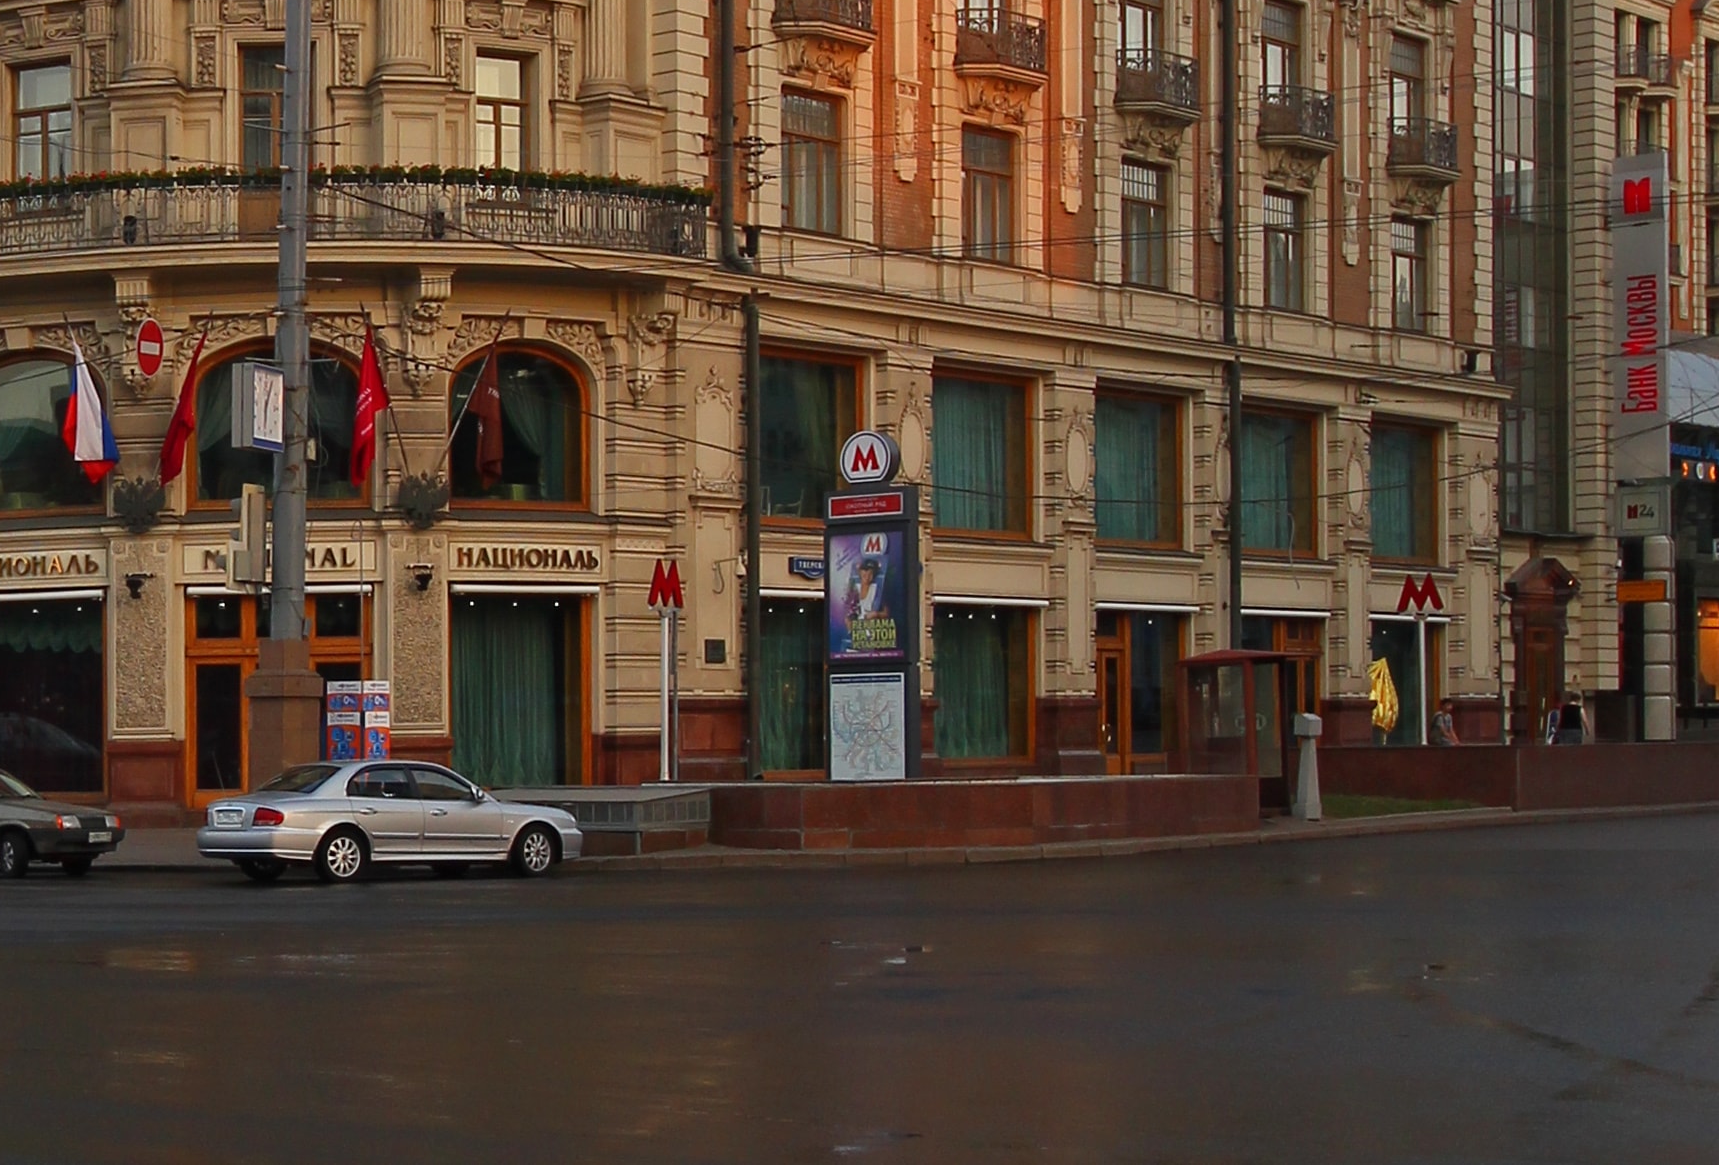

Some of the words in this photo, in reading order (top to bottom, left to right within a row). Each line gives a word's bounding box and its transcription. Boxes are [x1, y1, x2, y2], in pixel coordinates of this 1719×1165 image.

[1621, 274, 1657, 358] Москвы
[1622, 363, 1657, 413] Банк
[456, 546, 600, 571] НАЦИОНАЛЬ
